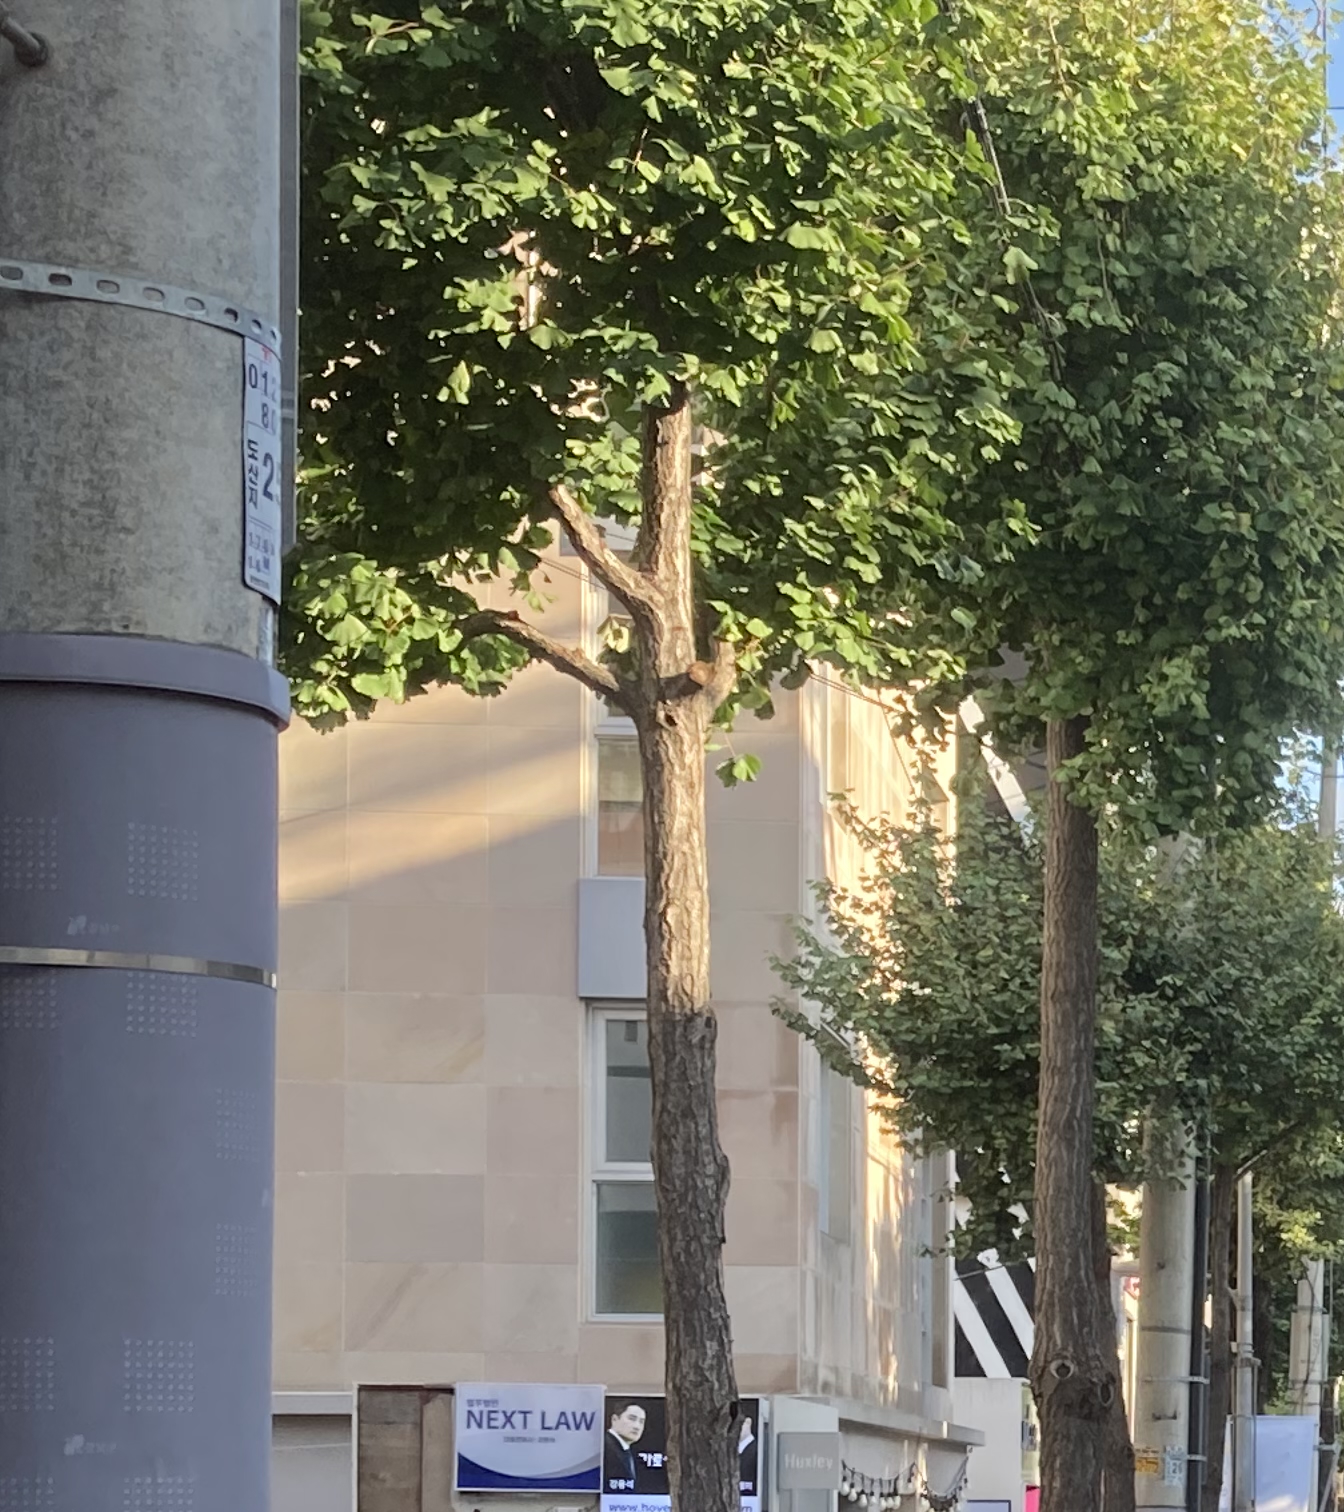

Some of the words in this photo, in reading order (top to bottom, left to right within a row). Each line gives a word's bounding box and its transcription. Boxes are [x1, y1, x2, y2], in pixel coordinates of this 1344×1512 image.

[466, 1410, 533, 1430] NEXT
[541, 1411, 596, 1431] LAW
[784, 1453, 834, 1471] Huxley
